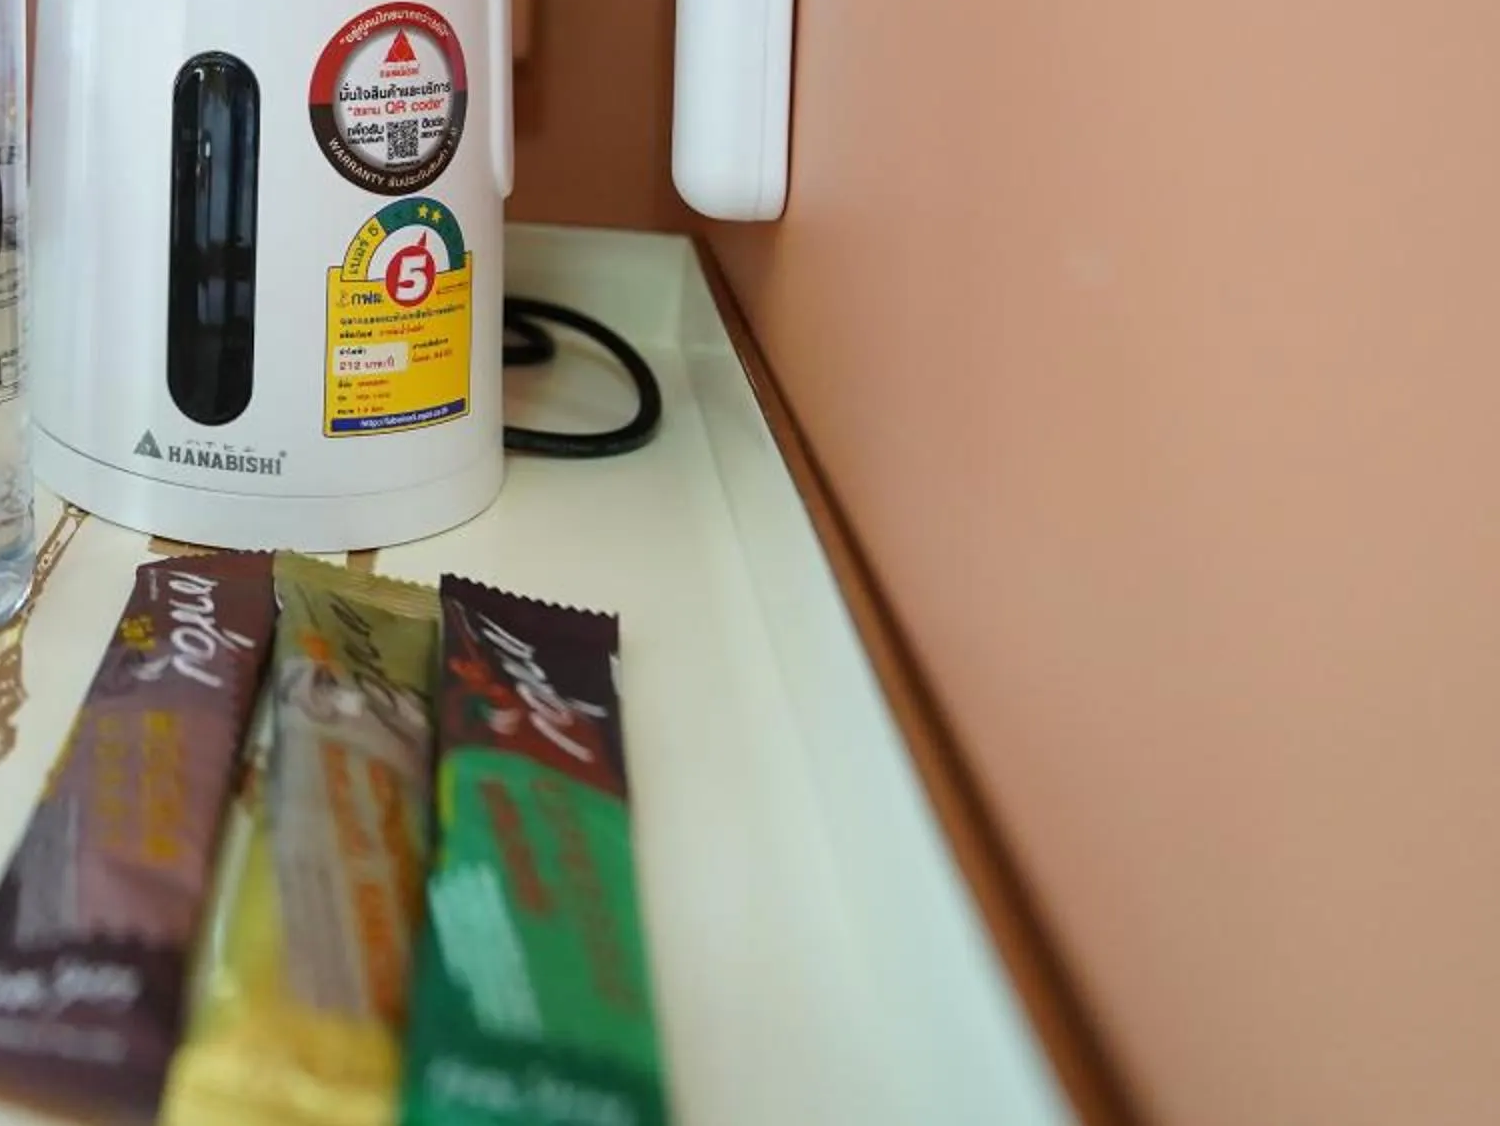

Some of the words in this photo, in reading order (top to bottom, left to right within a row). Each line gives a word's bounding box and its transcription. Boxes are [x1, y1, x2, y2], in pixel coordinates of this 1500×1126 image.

[385, 100, 406, 114] QR
[329, 137, 384, 186] WARRANTY
[395, 255, 428, 303] 5
[168, 445, 283, 476] HANABISHI
